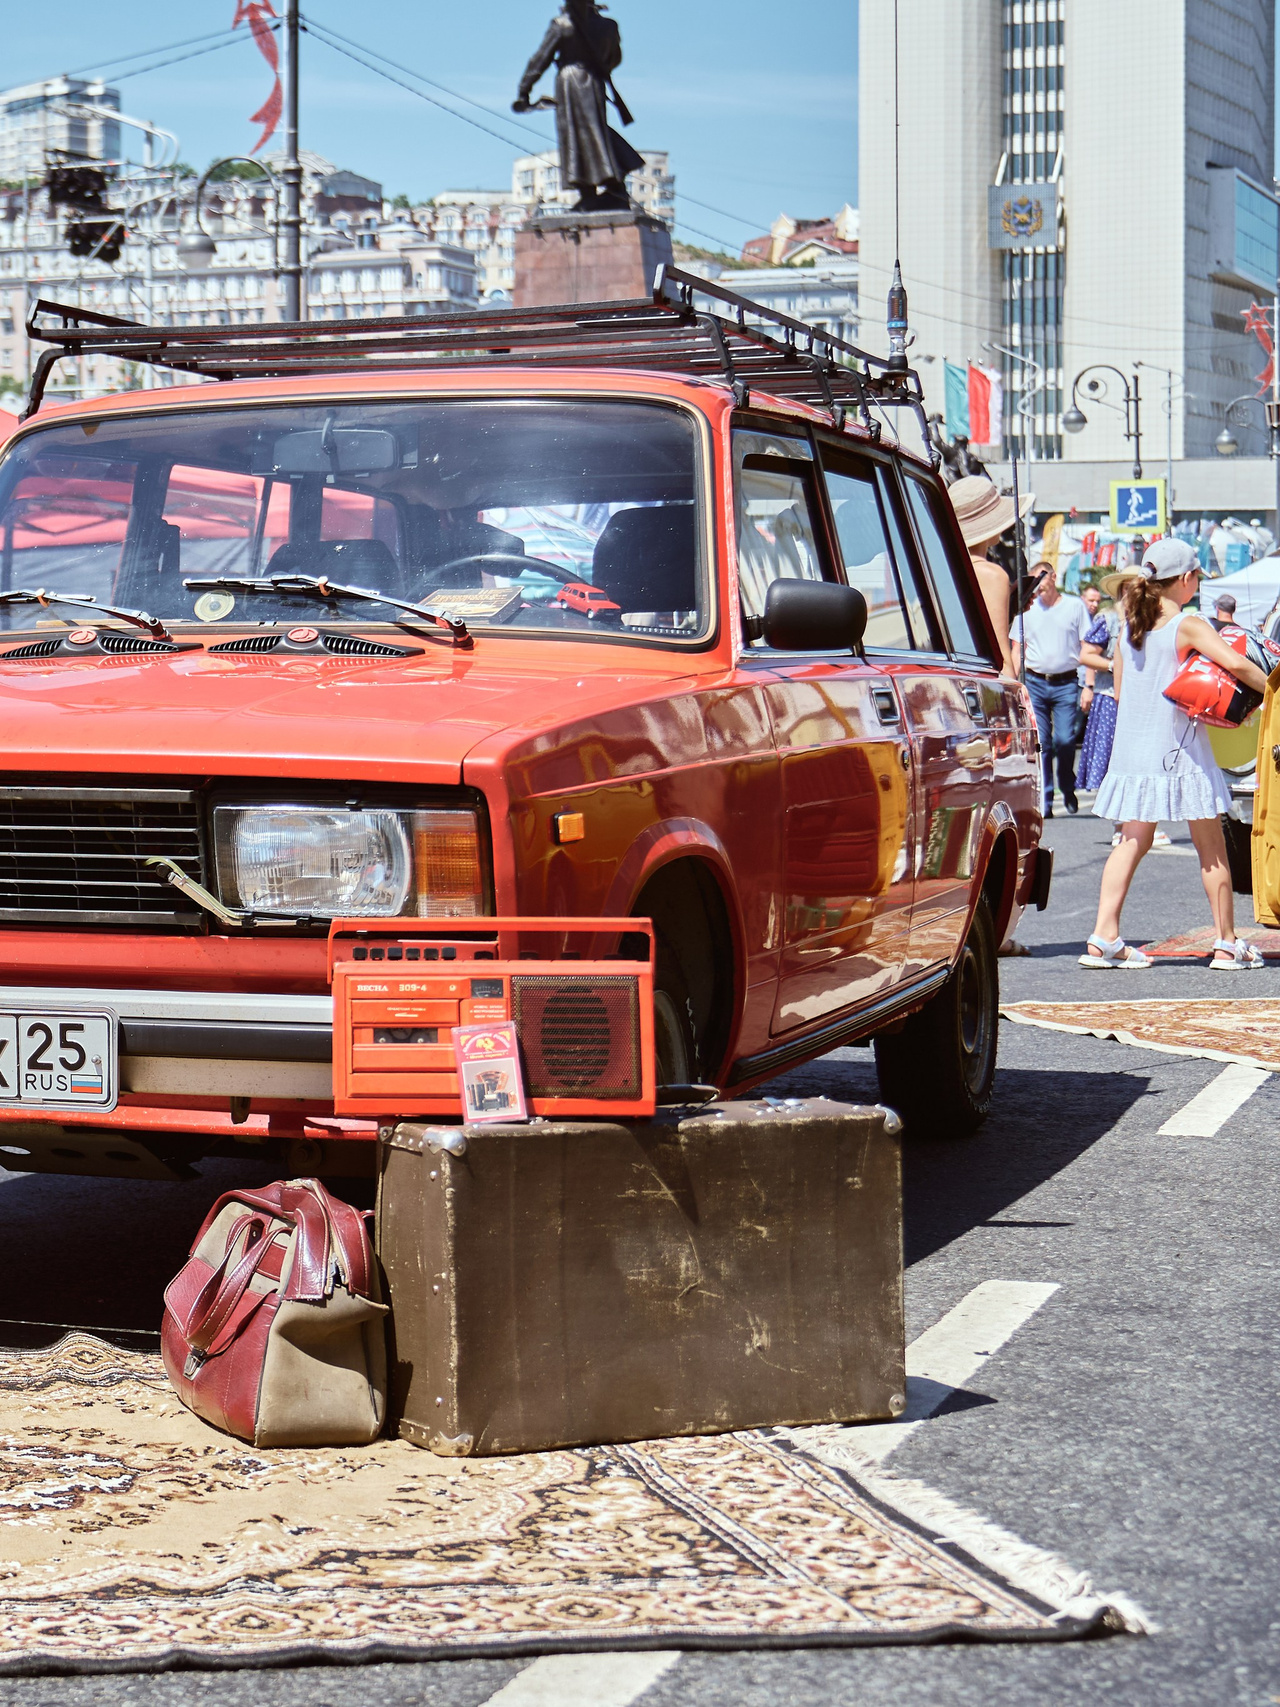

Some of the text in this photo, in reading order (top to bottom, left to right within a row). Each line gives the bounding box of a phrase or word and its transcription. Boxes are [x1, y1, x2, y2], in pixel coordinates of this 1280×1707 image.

[357, 984, 427, 992] ВЕСНА 309-4
[26, 1022, 87, 1072] 25
[24, 1073, 68, 1092] RUS
